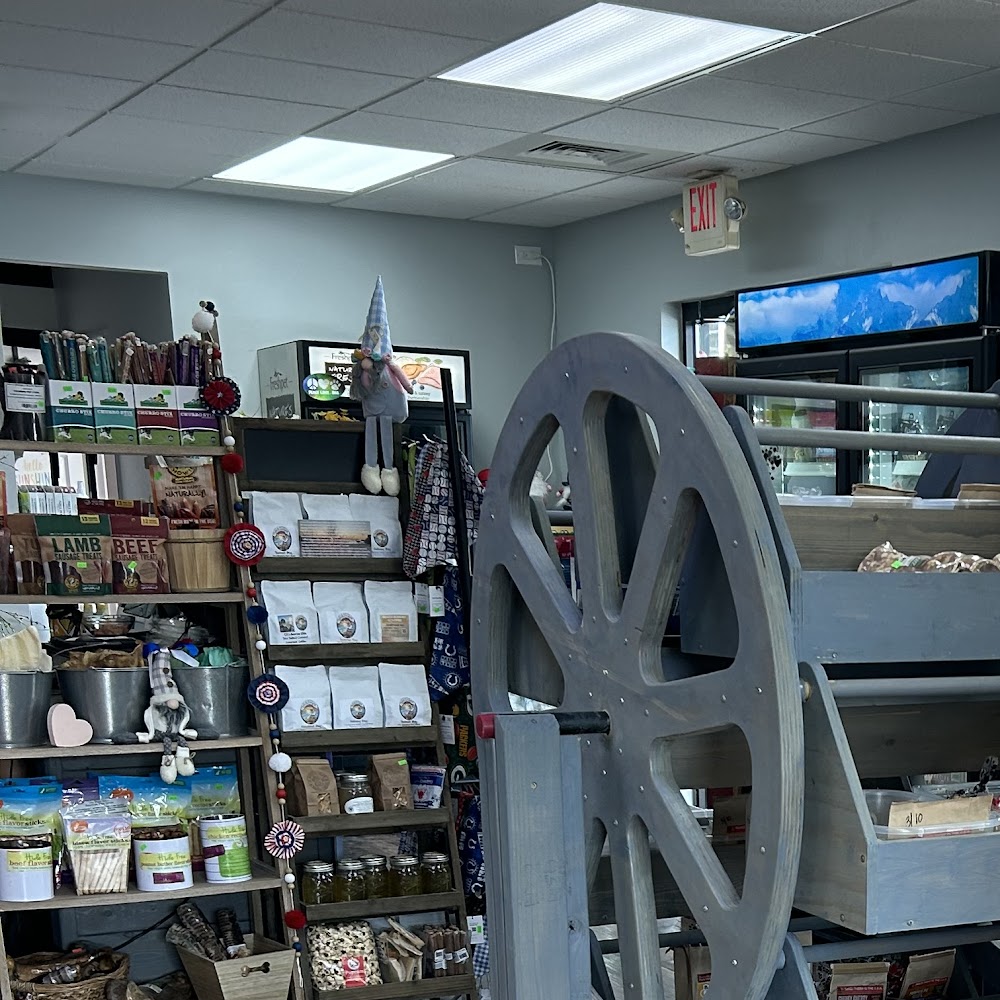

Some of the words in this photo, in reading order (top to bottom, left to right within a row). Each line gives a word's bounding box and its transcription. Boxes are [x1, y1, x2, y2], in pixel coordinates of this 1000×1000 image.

[690, 182, 717, 232] EXIT
[52, 538, 101, 552] LAMB
[112, 539, 158, 554] BEEF
[460, 724, 468, 758] PACKERS
